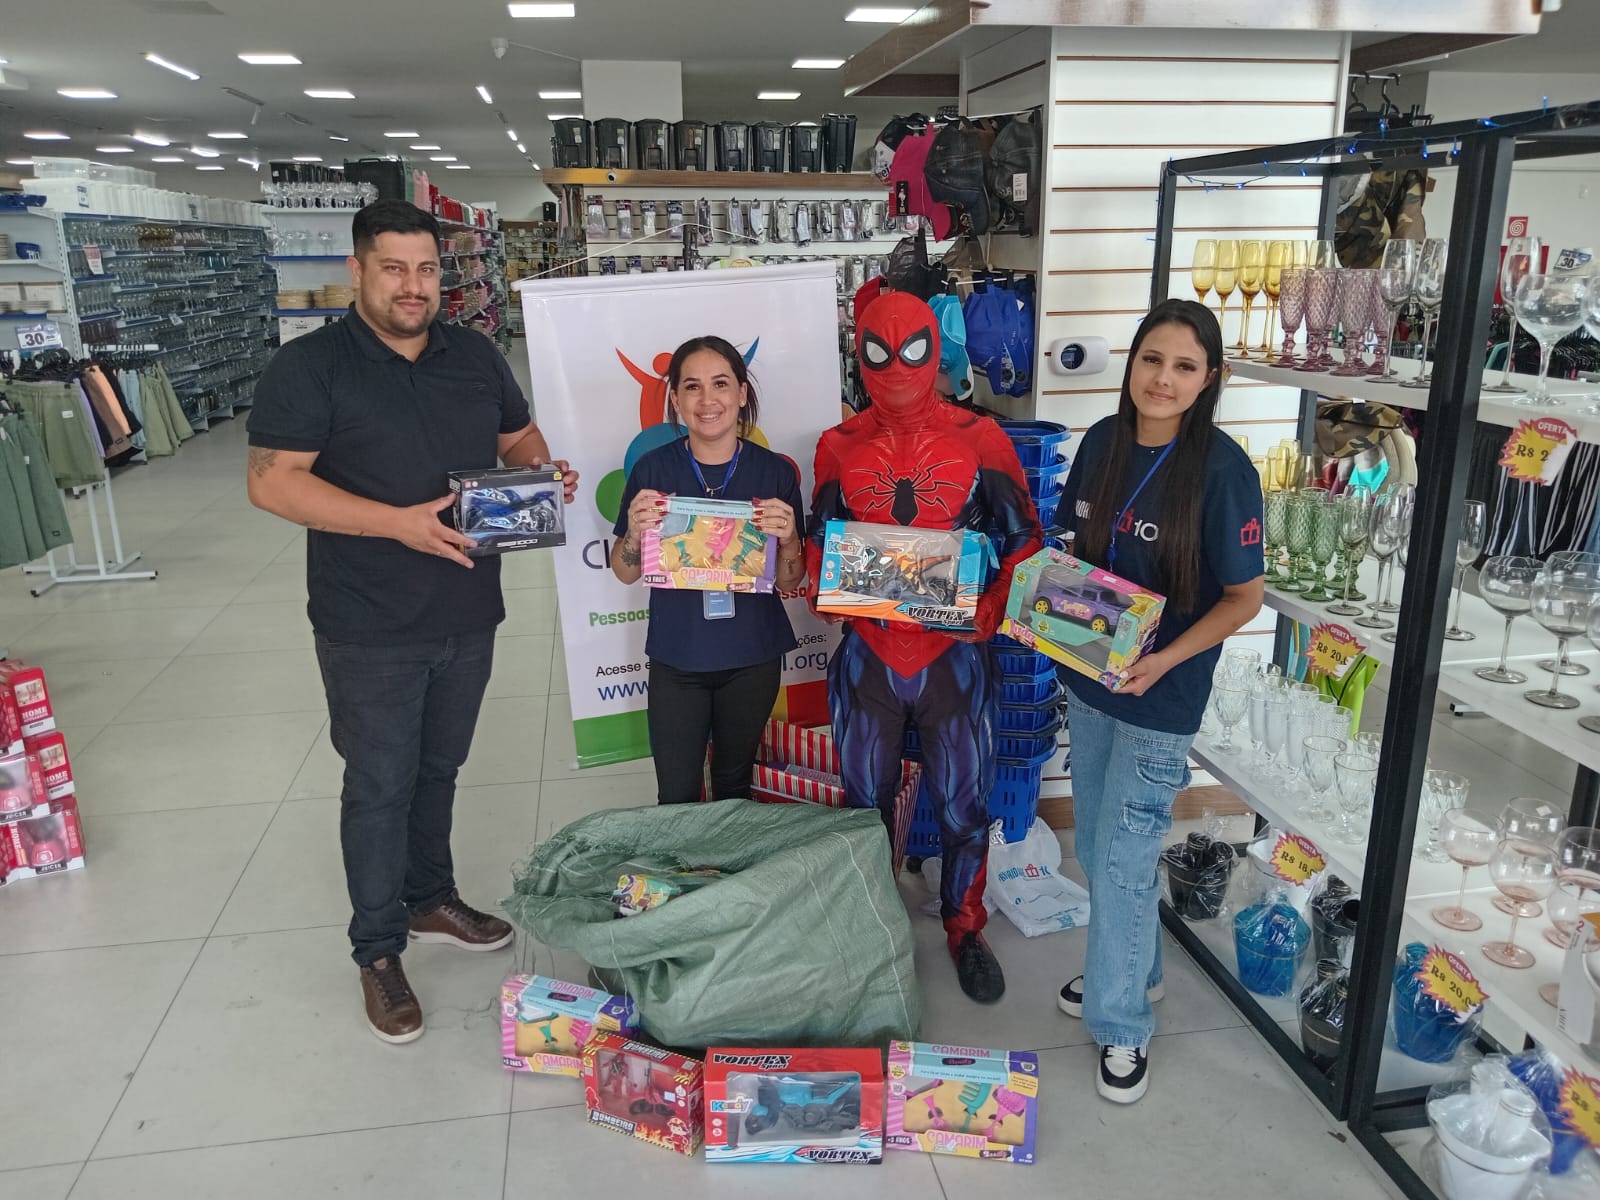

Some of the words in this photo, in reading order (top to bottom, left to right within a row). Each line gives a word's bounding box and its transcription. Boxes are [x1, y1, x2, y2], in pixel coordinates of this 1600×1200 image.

[25, 333, 45, 346] 30
[1537, 422, 1569, 434] OFERTA
[797, 633, 828, 648] ções:
[781, 651, 828, 671] l.org
[596, 662, 642, 678] Acesse
[22, 706, 48, 720] HOME
[931, 1045, 991, 1058] CAMARIM
[713, 1053, 792, 1067] VORTEX
[591, 1110, 634, 1131] BOMBEIRO
[808, 1150, 871, 1160] VORTEX
